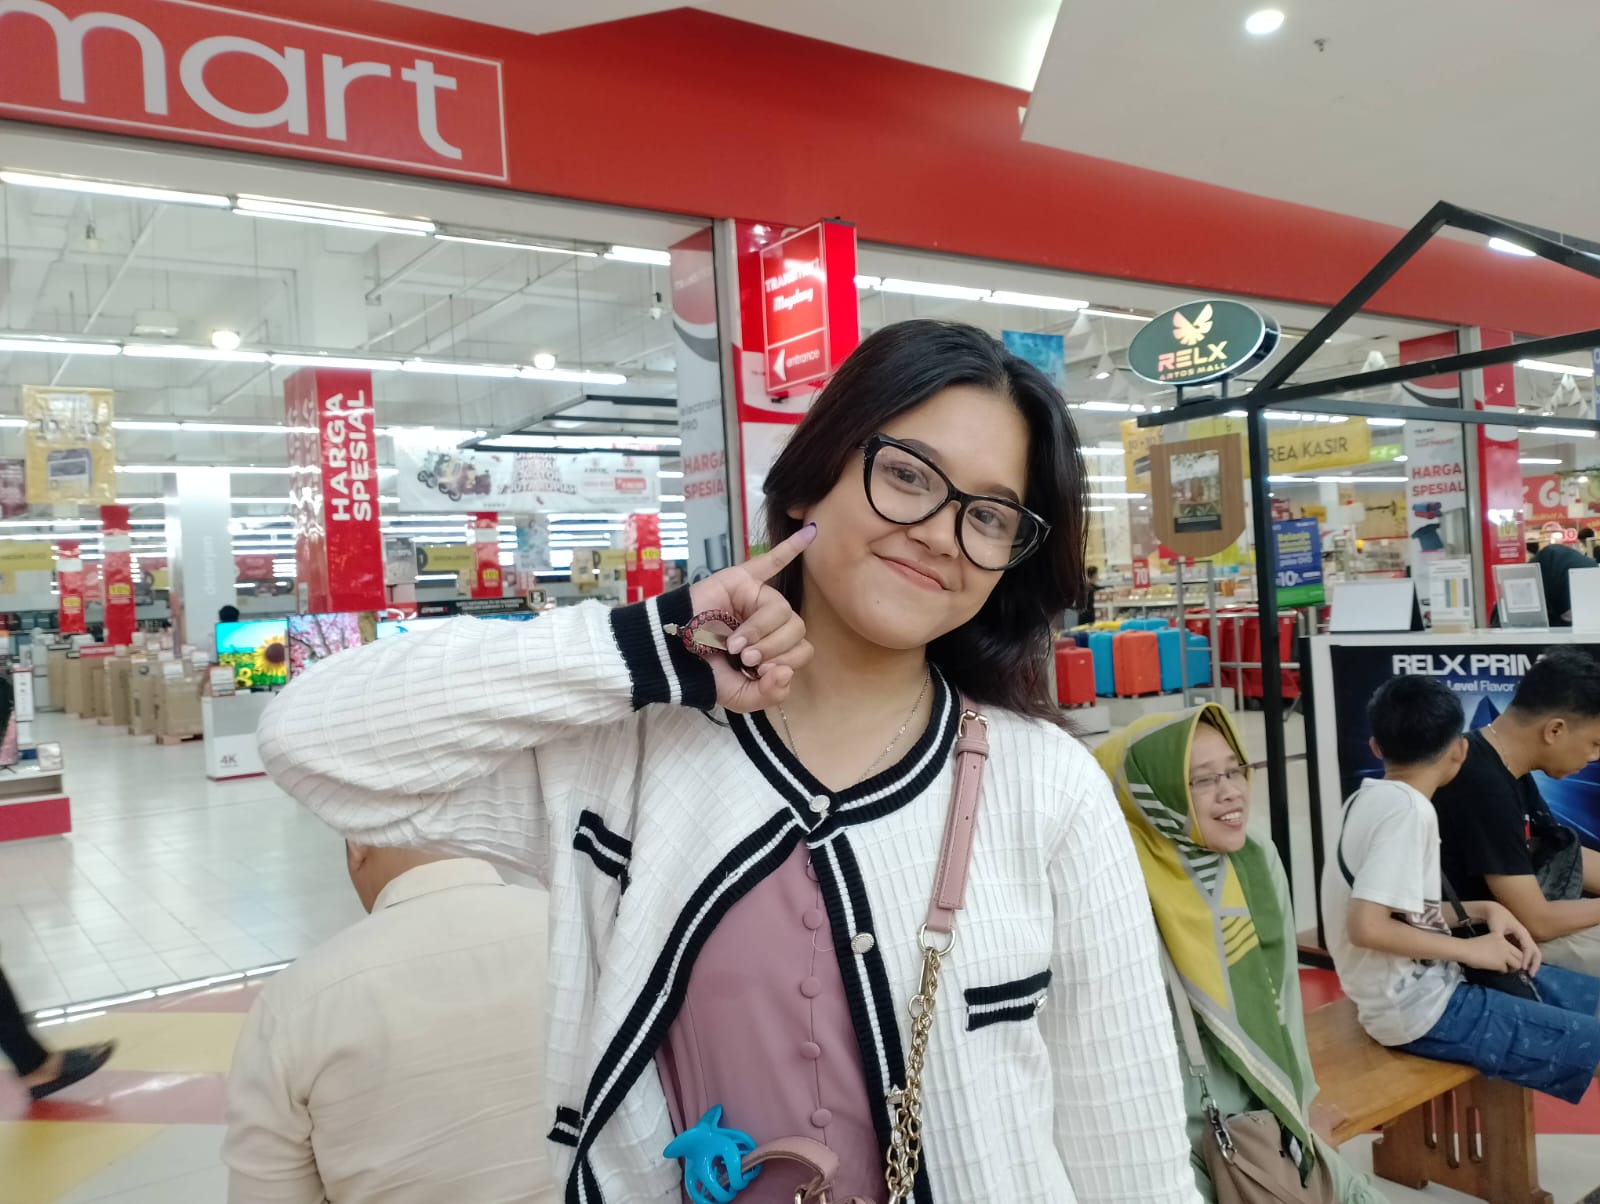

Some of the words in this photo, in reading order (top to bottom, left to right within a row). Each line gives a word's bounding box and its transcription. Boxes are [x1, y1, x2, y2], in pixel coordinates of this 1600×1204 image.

[0, 10, 463, 160] mart
[786, 349, 820, 368] entrance
[1158, 341, 1228, 372] RELX
[1159, 368, 1195, 381] ARTOS
[1197, 363, 1227, 374] MALL
[325, 393, 351, 521] HARGA
[347, 390, 371, 521] SPESIAL
[1268, 445, 1298, 462] REA
[1303, 436, 1349, 458] KASIR
[1412, 462, 1462, 479] HARGA
[684, 478, 726, 500] SPESIA
[1412, 480, 1466, 497] SPESIAL
[1392, 654, 1467, 676] RELX
[1470, 654, 1547, 677] PRIM
[1447, 680, 1478, 692] Level
[1480, 679, 1515, 692] Flavor
